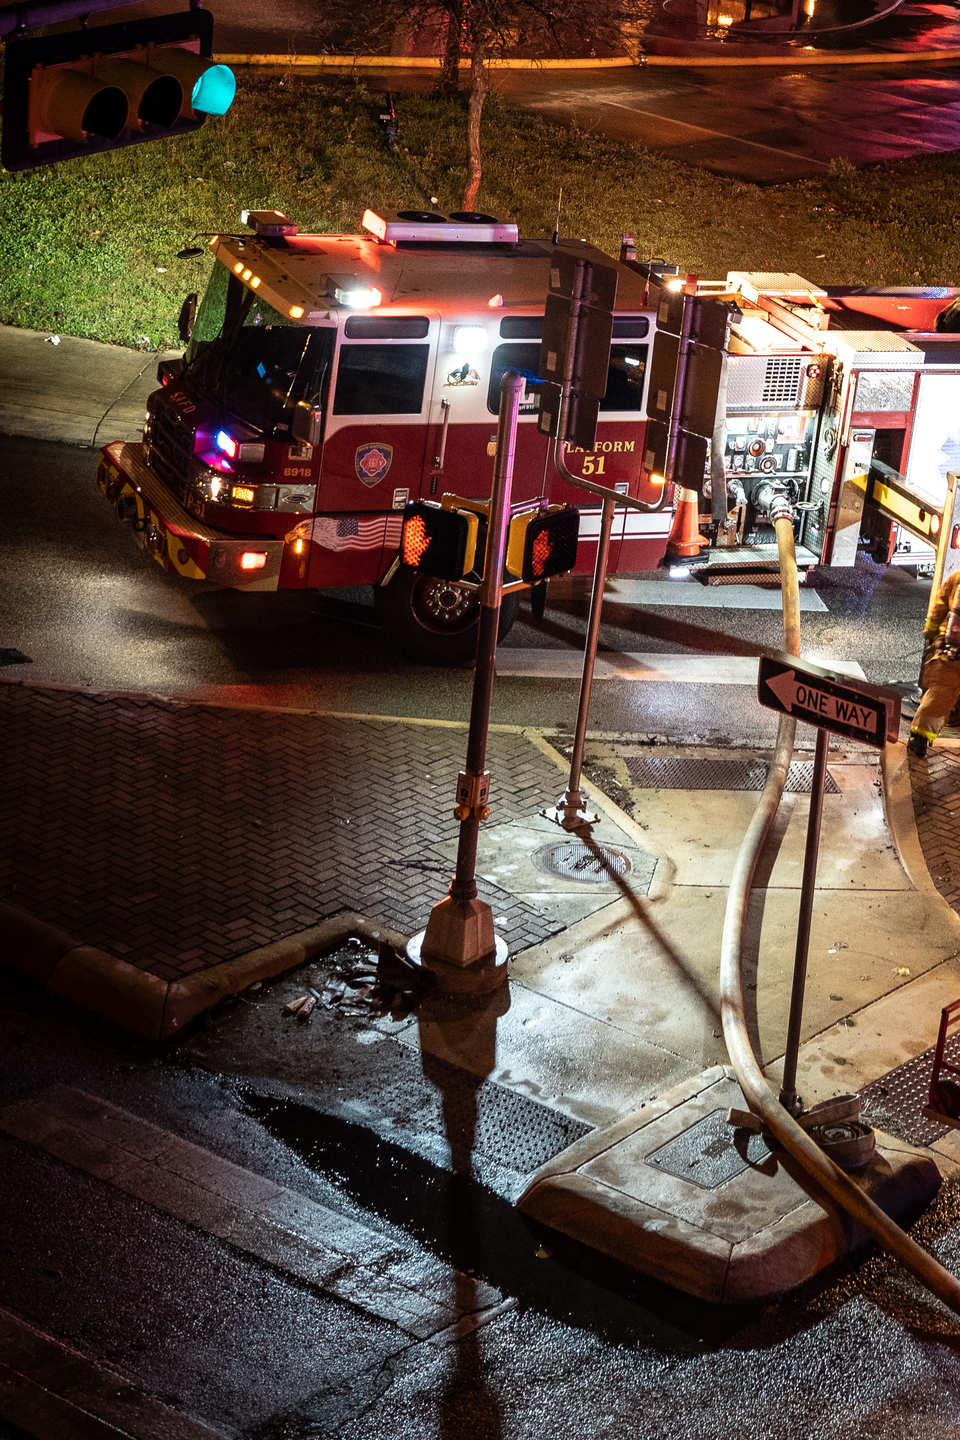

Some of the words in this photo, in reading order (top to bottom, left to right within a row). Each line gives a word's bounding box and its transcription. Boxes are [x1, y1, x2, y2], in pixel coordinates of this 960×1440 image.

[169, 391, 197, 414] SAFD
[564, 440, 636, 453] LAFORM
[283, 467, 313, 478] 8918
[581, 455, 606, 475] 51
[796, 686, 829, 715] ONE
[835, 700, 872, 728] WAY
